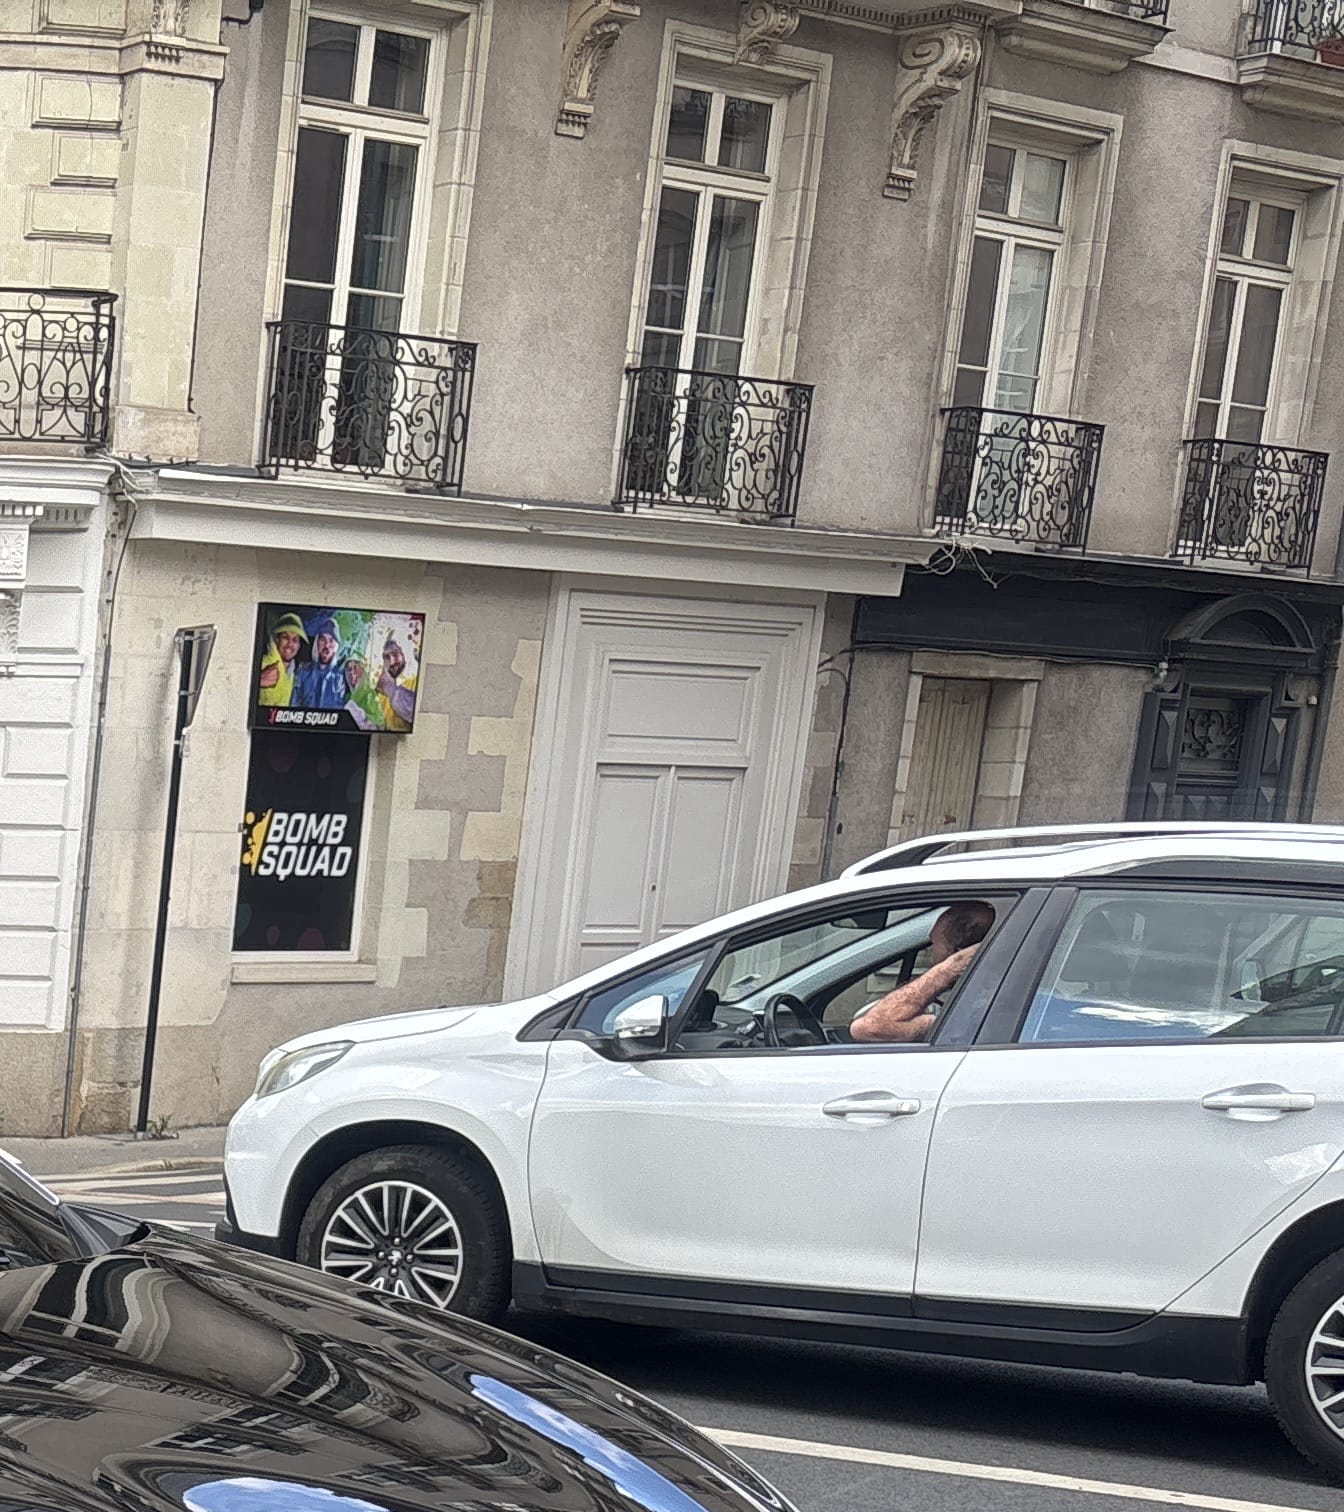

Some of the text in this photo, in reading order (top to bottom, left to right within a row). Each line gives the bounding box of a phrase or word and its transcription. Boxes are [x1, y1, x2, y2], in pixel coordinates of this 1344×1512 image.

[275, 710, 339, 727] BOMB SQUAD
[266, 812, 348, 844] BOMB
[258, 844, 353, 881] SQUAD
